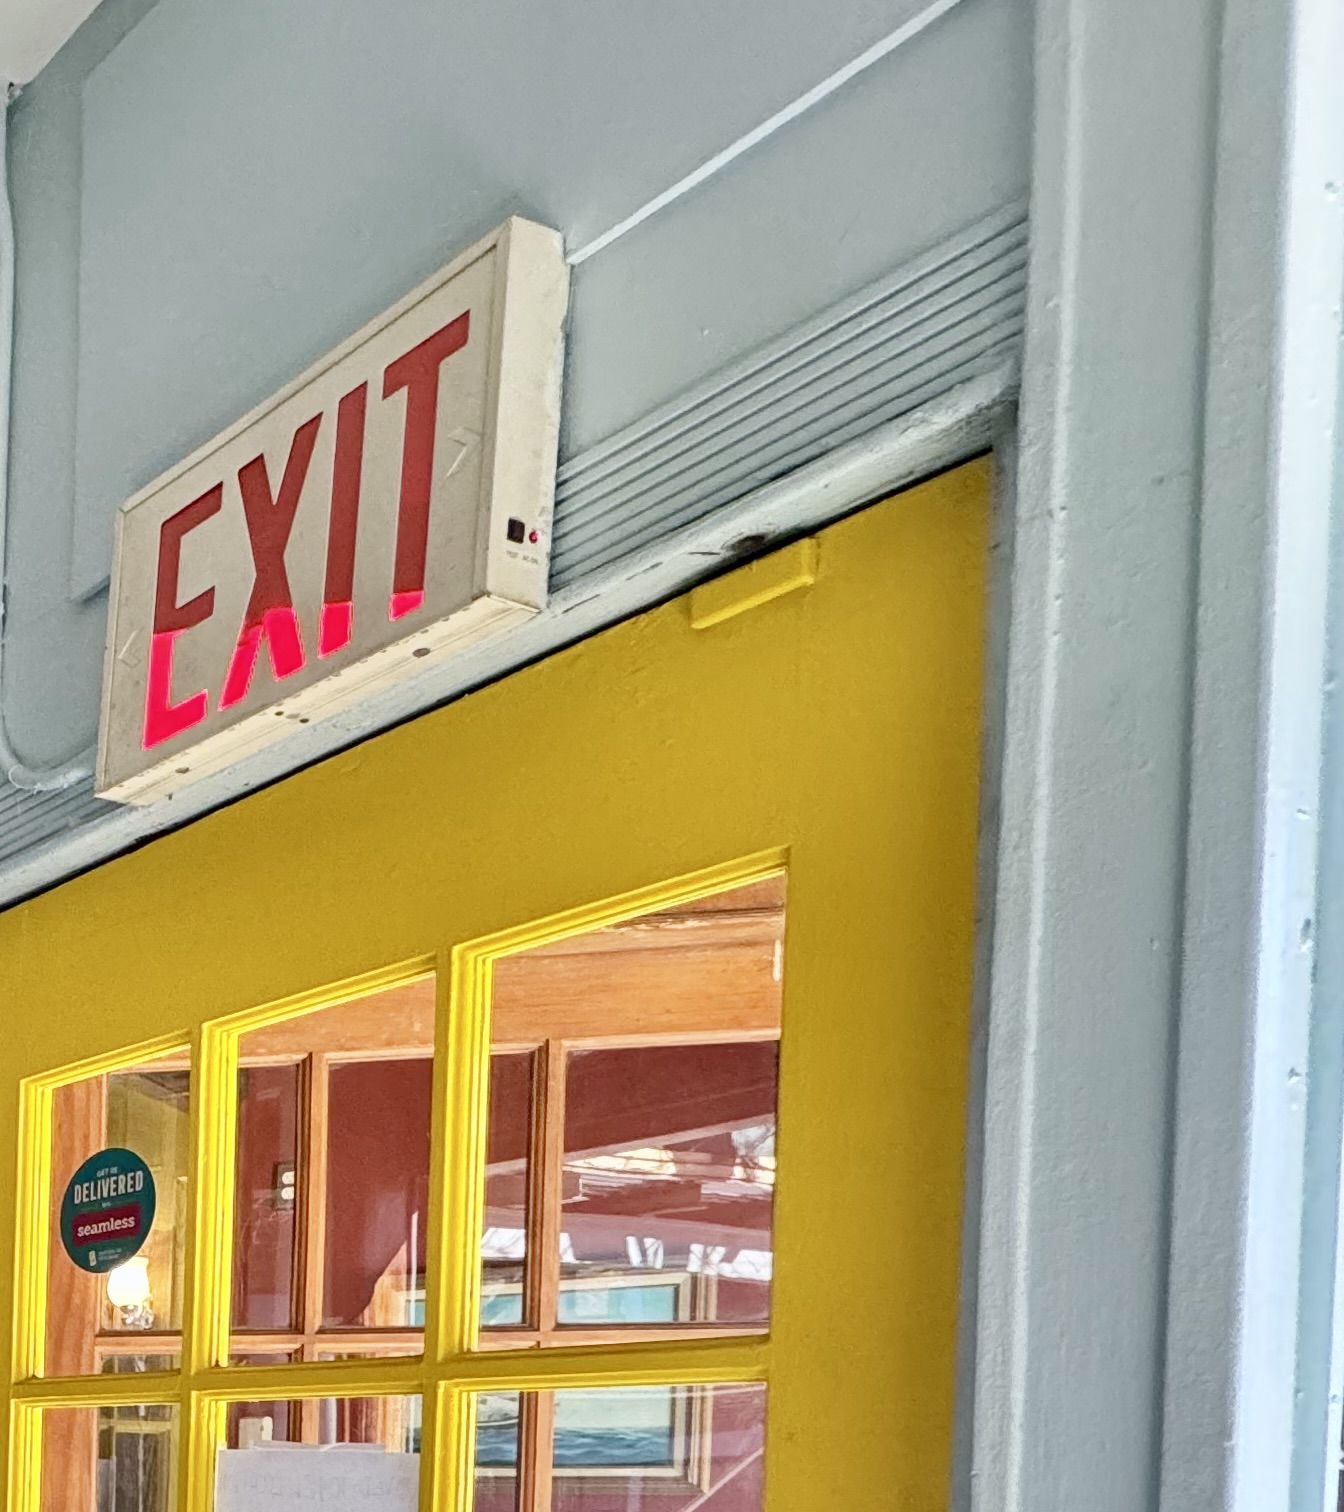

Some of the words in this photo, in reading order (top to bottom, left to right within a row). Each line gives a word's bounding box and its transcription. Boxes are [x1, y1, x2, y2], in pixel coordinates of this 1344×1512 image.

[143, 309, 470, 750] EXIT
[74, 1171, 143, 1204] DELIVERED
[77, 1216, 136, 1237] seamless
